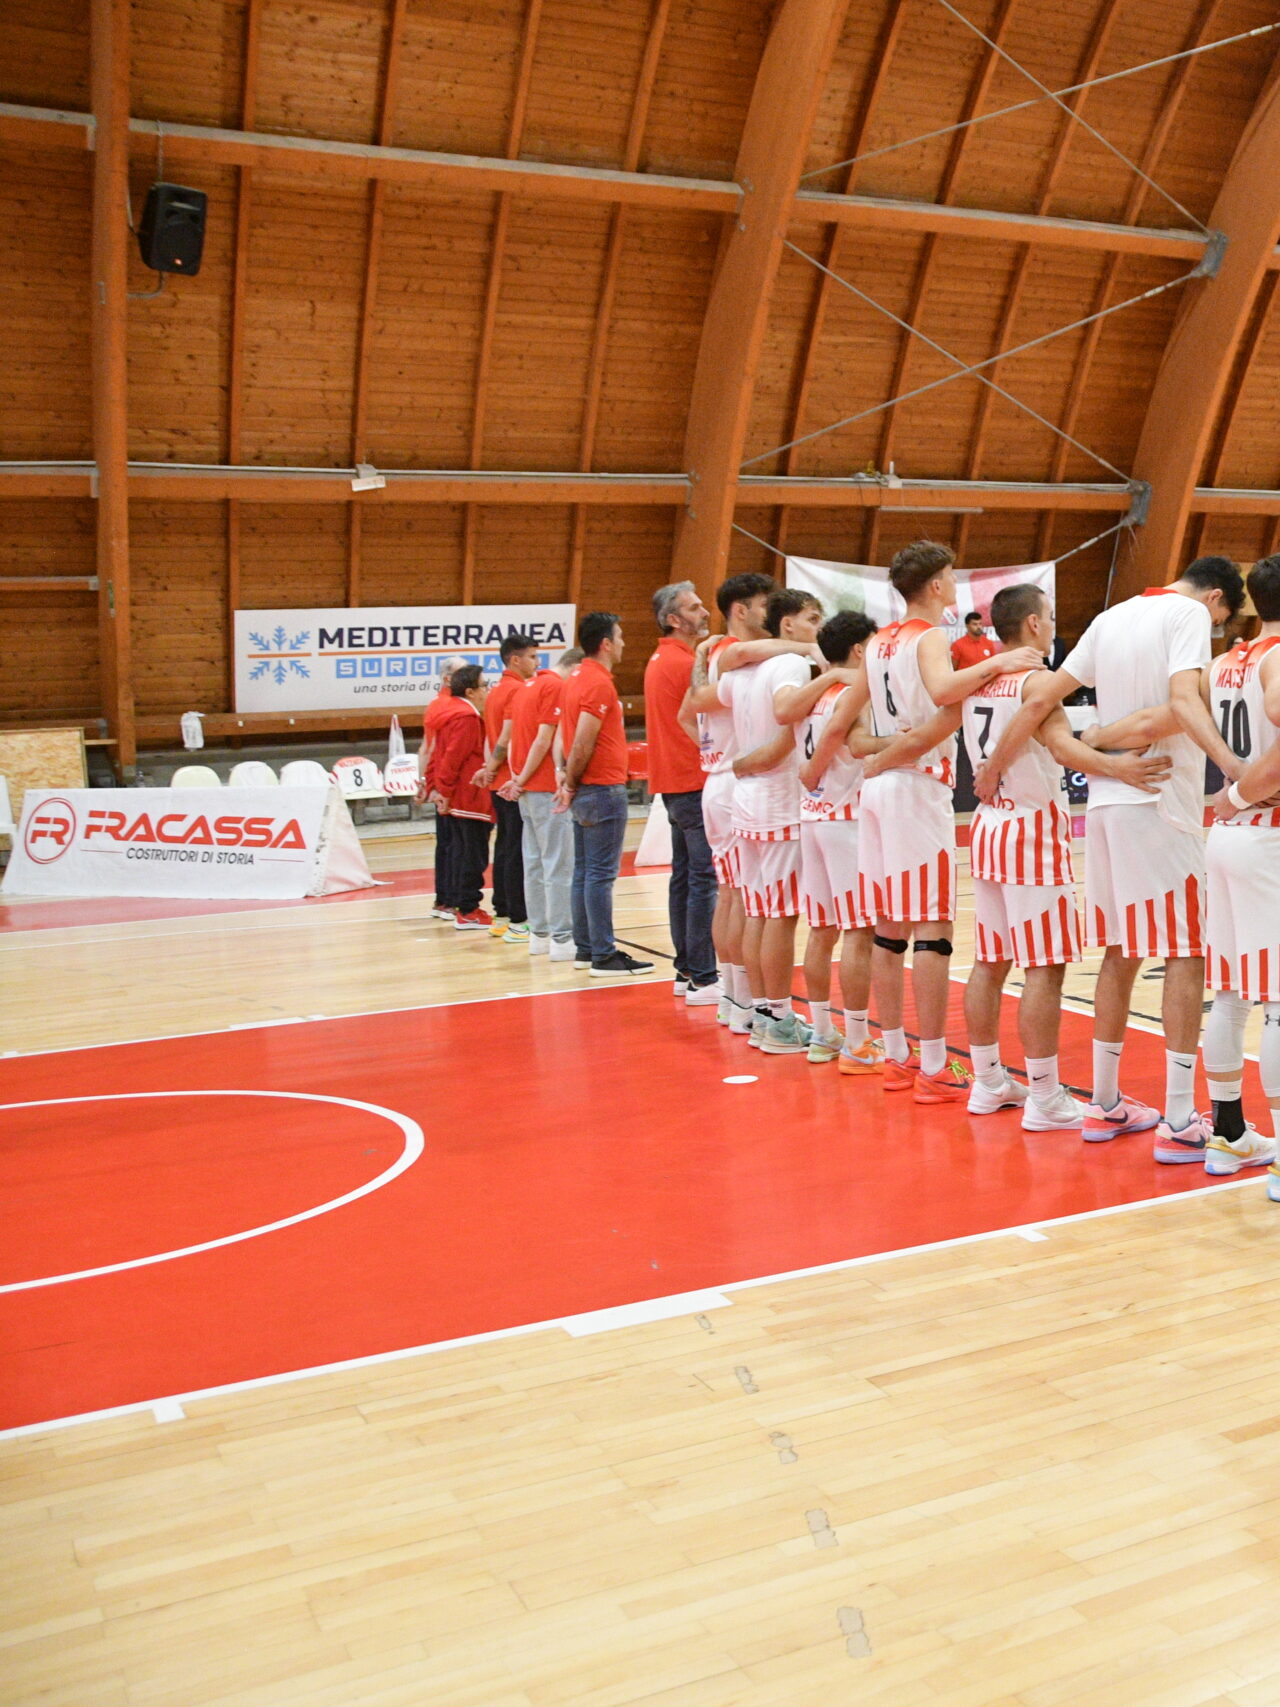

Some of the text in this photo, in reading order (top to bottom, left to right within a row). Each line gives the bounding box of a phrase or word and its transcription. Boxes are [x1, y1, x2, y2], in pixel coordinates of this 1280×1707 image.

[318, 623, 565, 649] MEDITERRANEA
[339, 656, 543, 676] SURGA
[354, 684, 377, 694] una
[381, 681, 416, 693] storia
[420, 681, 431, 692] di
[973, 706, 994, 759] 7
[1219, 697, 1252, 758] 10
[353, 768, 363, 787] 8
[30, 816, 70, 845] FR
[84, 810, 307, 849] FRACASSA
[126, 847, 254, 865] COSTRUTTORI DI STORIA
